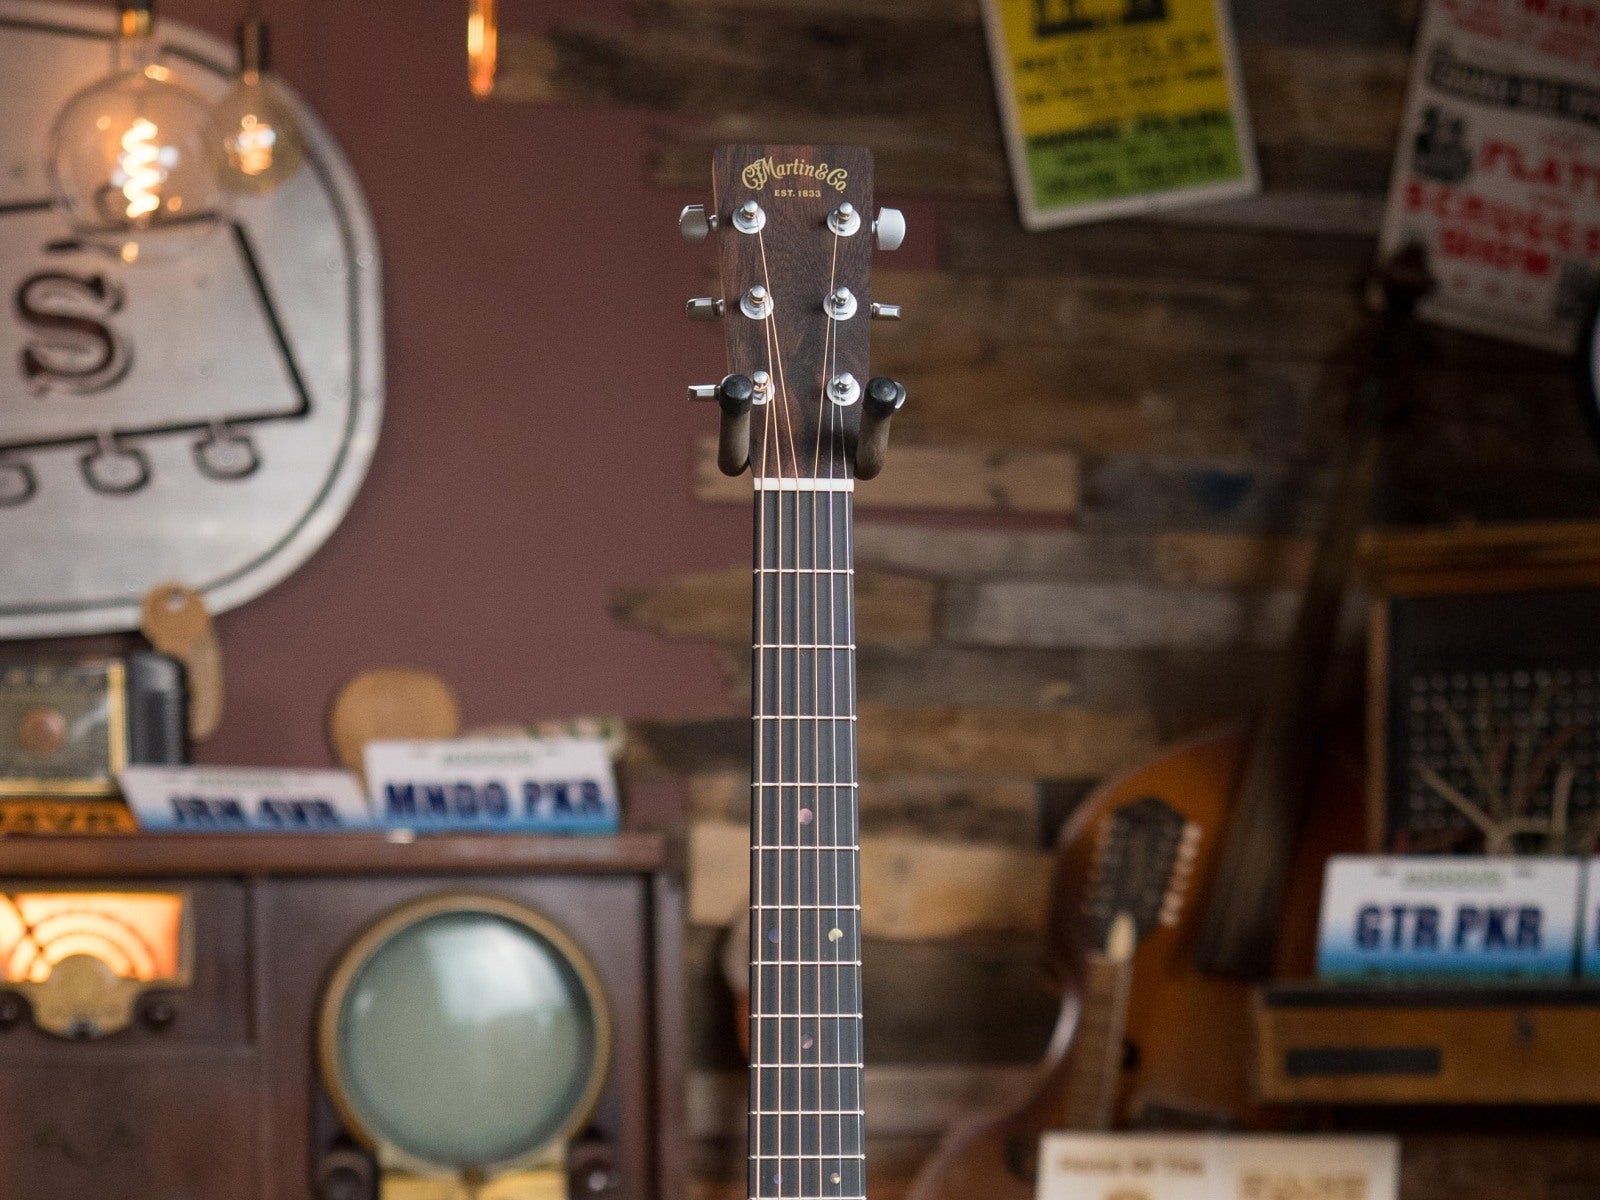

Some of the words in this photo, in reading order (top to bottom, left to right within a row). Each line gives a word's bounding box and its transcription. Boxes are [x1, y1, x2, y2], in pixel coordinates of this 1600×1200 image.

[774, 189, 796, 198] EST.
[798, 189, 822, 198] 1833
[1355, 902, 1440, 951] GTR
[1454, 902, 1542, 951] PKR
